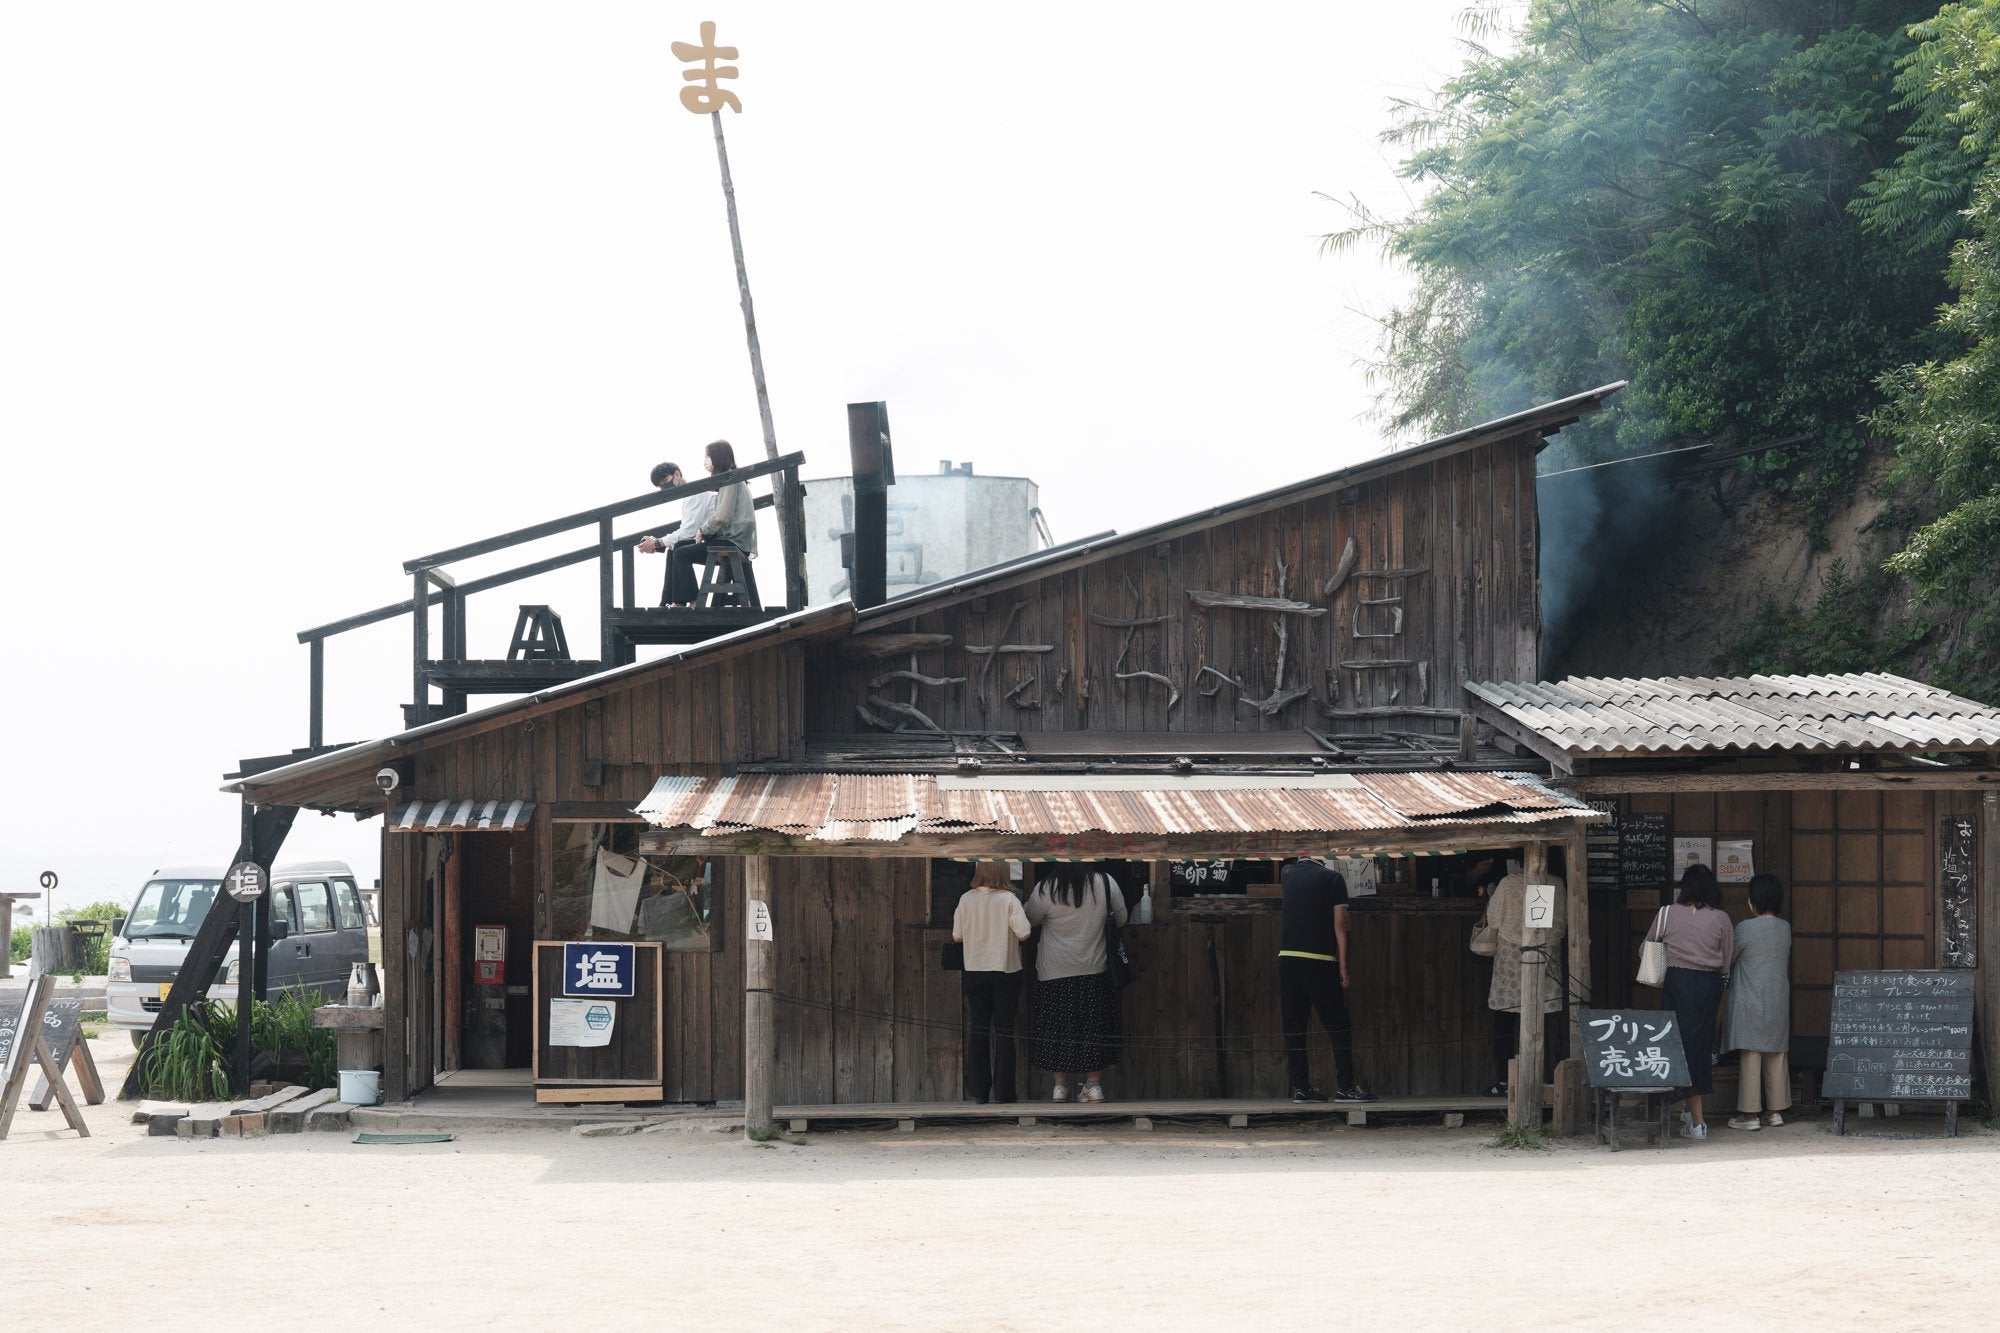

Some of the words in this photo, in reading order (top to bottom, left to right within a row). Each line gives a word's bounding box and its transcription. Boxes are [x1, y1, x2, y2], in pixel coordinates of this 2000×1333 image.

[671, 20, 742, 114] ま
[230, 866, 262, 896] 塩
[1719, 864, 1734, 875] SOLD
[1734, 864, 1749, 874] OUT
[754, 906, 768, 932] 出口
[1531, 888, 1548, 921] 入口
[575, 950, 623, 989] 塩
[1884, 986, 1922, 997] プレーン
[1588, 1014, 1673, 1045] プリン
[1599, 1045, 1671, 1080] 売場
